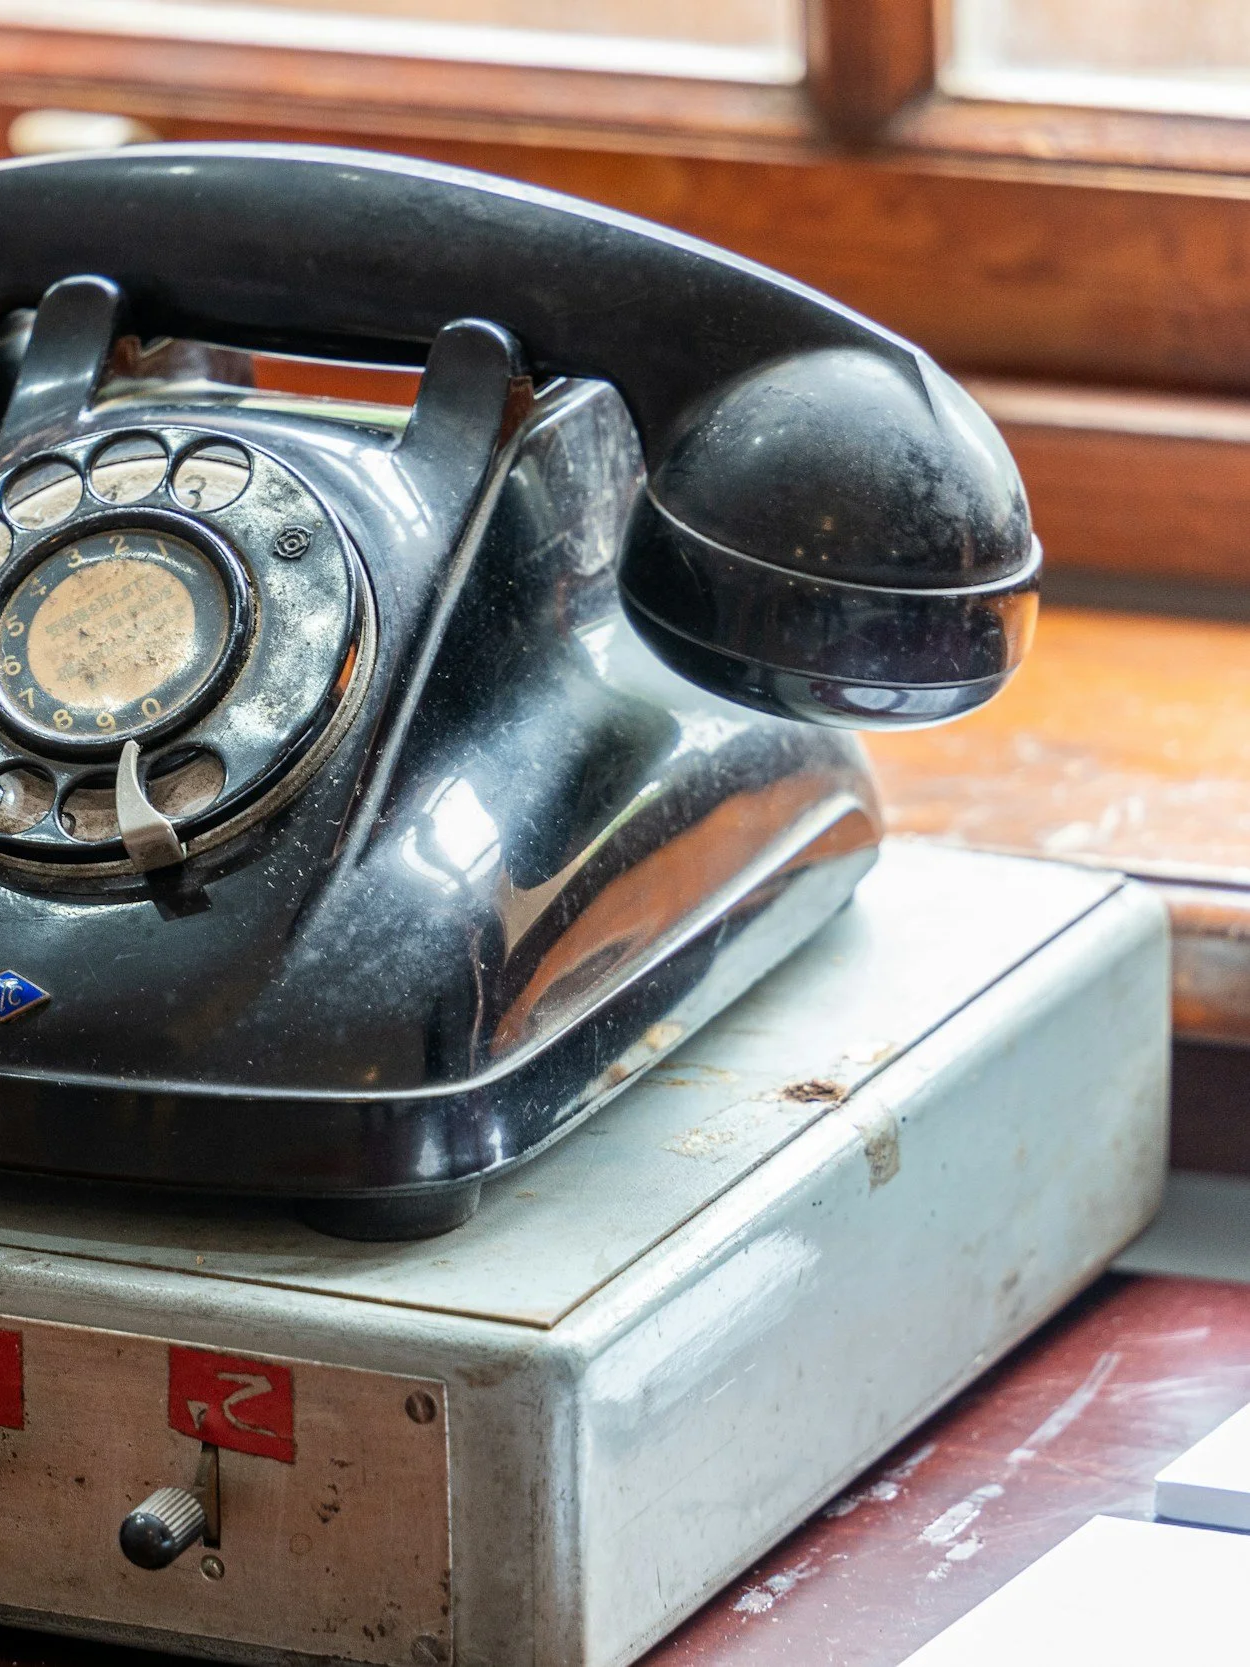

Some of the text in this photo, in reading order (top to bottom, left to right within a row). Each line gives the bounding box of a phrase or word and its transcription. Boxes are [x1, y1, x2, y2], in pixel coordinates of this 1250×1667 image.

[184, 474, 207, 509] 3
[109, 535, 130, 555] 2
[66, 548, 83, 568] 3
[29, 576, 47, 597] 4
[5, 615, 24, 637] 5
[3, 655, 22, 676] 6
[18, 689, 35, 709] 7
[141, 697, 162, 718] 0
[52, 709, 73, 730] 8
[96, 712, 116, 733] 9
[216, 1371, 278, 1438] 2
